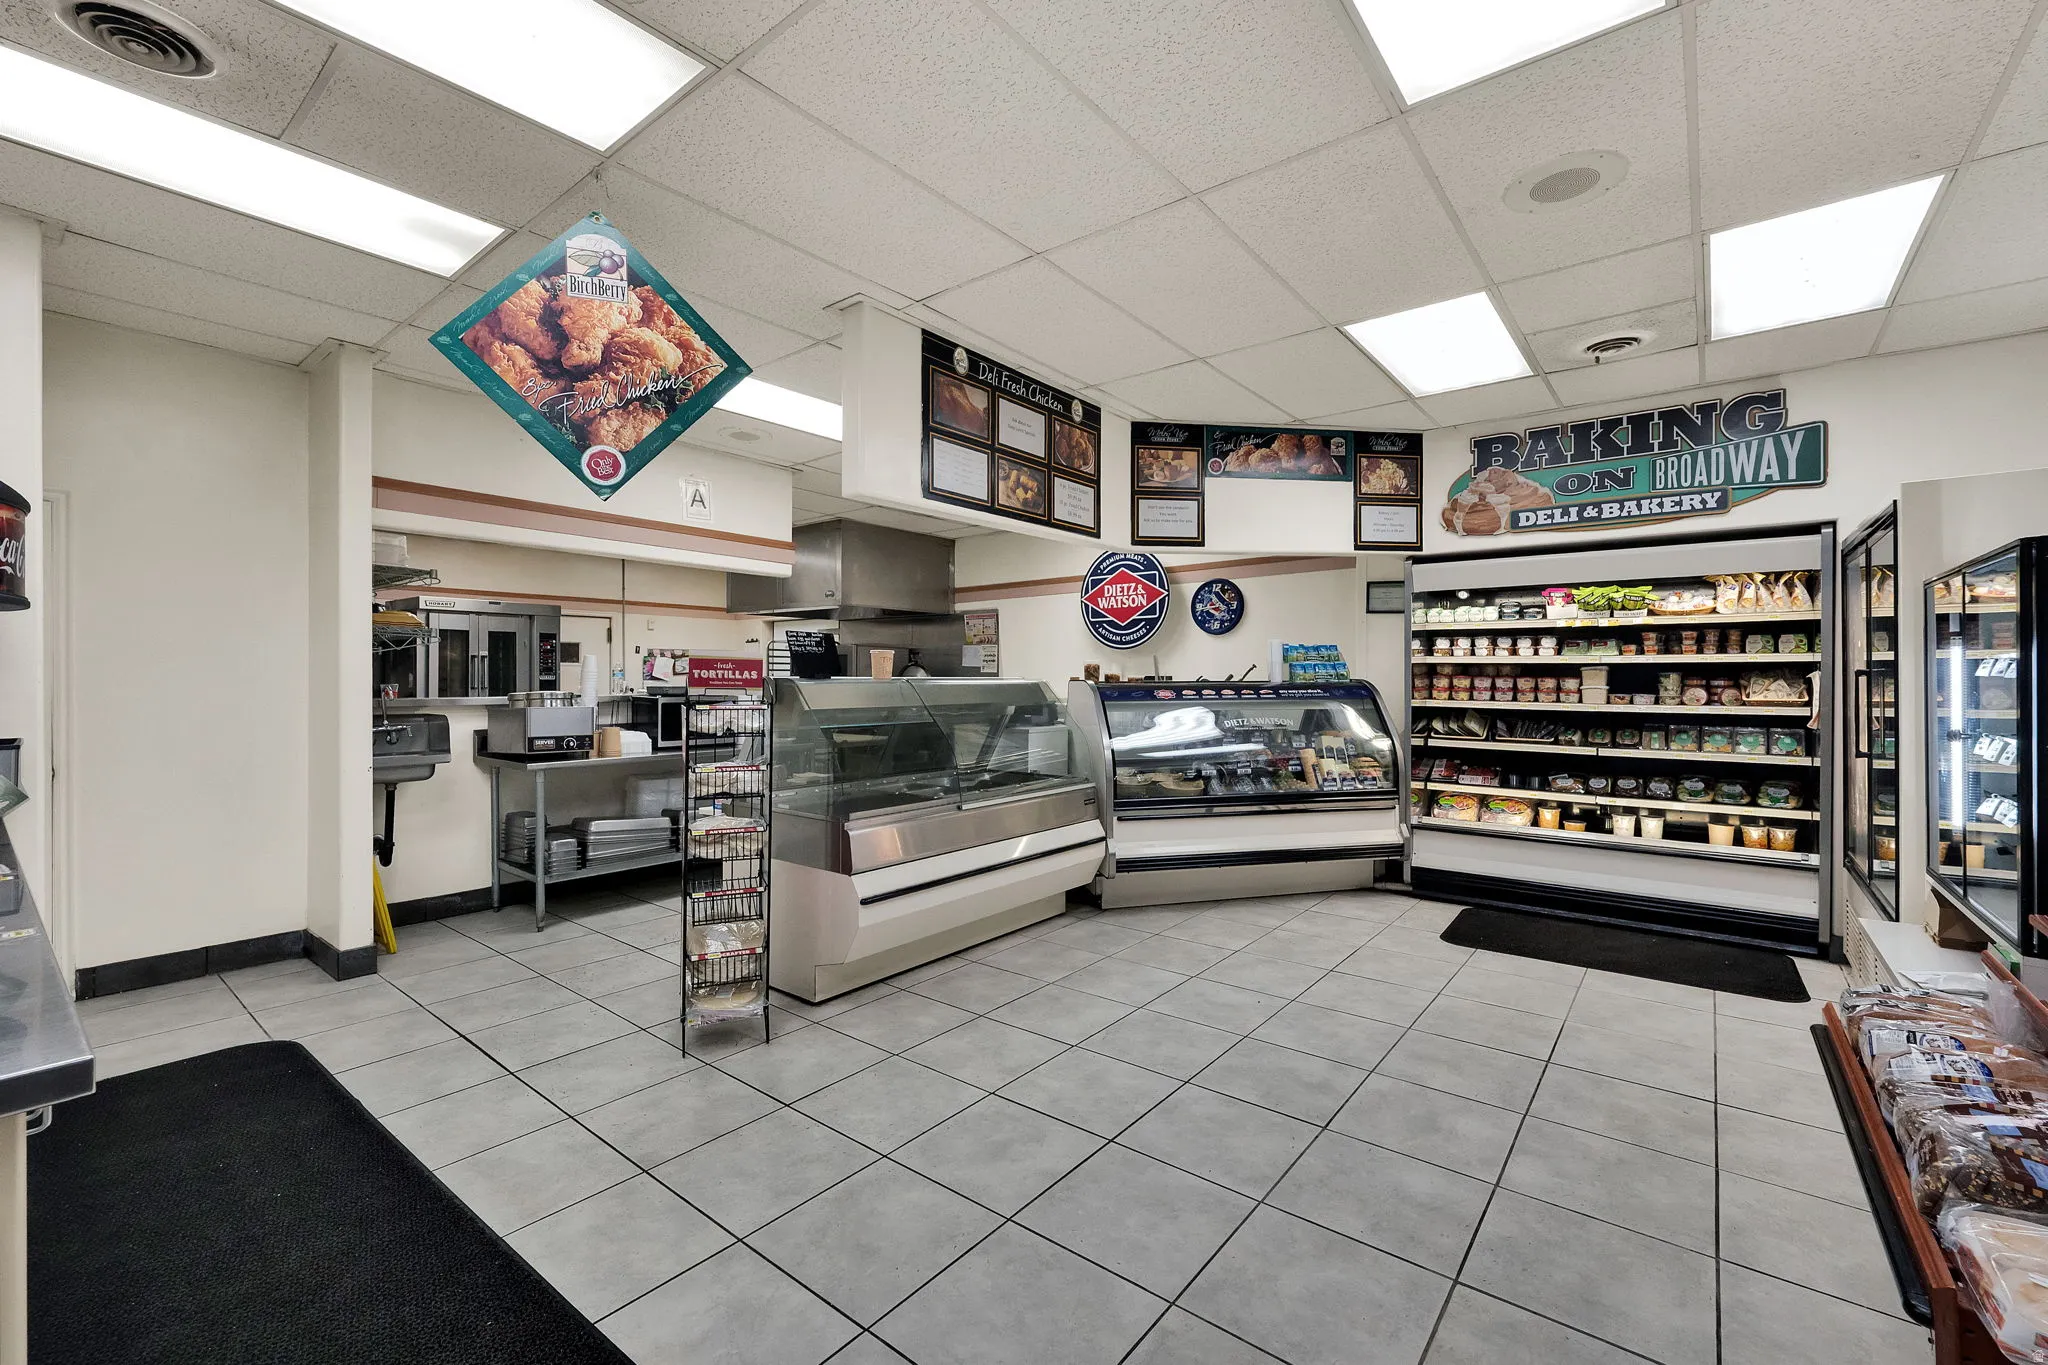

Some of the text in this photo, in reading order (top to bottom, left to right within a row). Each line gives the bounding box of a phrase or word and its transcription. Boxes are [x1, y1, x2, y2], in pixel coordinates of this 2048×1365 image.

[569, 275, 626, 301] BirchBerry
[539, 380, 613, 424] Fried
[616, 364, 723, 406] Chicken
[978, 362, 999, 386] Deli
[1001, 371, 1026, 398] Fresh
[1028, 384, 1063, 413] Chicken
[1471, 388, 1788, 476] BAKING
[591, 456, 613, 470] Only
[1553, 431, 1805, 495] ON BROADWAY
[690, 489, 707, 510] A
[1518, 492, 1722, 527] DELI & BAKERY
[1100, 553, 1145, 571] PREMIUM MEATS
[1104, 583, 1146, 598] DIETZ &
[1212, 584, 1222, 592] 12
[1097, 594, 1147, 609] WATSON
[1230, 601, 1237, 610] 3
[1214, 621, 1221, 629] 6
[1098, 628, 1147, 642] ARTISAN CHEESES
[693, 670, 758, 679] TORTILLAS
[1223, 718, 1249, 727] DIETZ
[1257, 717, 1294, 726] WATSON
